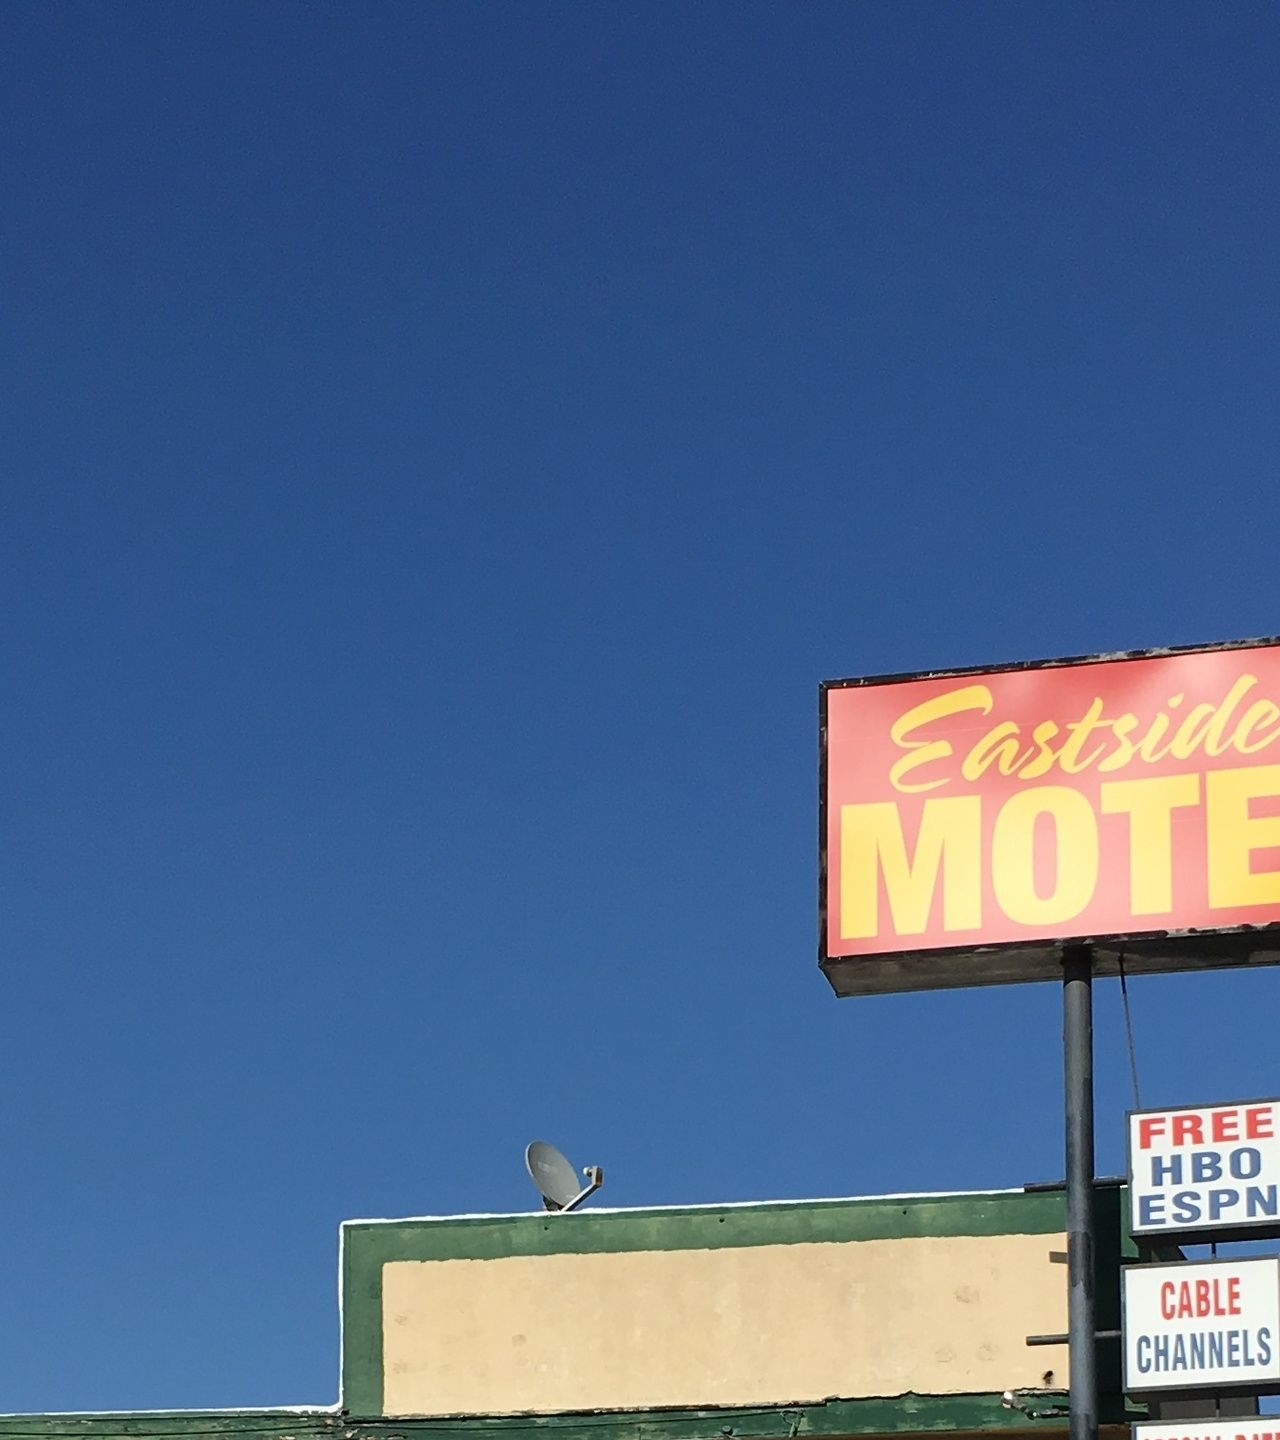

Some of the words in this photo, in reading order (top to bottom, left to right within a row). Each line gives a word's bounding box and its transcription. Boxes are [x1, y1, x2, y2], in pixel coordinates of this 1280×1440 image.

[1138, 1106, 1275, 1150] FREE
[1150, 1146, 1262, 1188] HBO
[1137, 1184, 1279, 1227] ESPN
[1159, 1276, 1242, 1321] CABLE
[1135, 1326, 1272, 1374] CHANNELS
